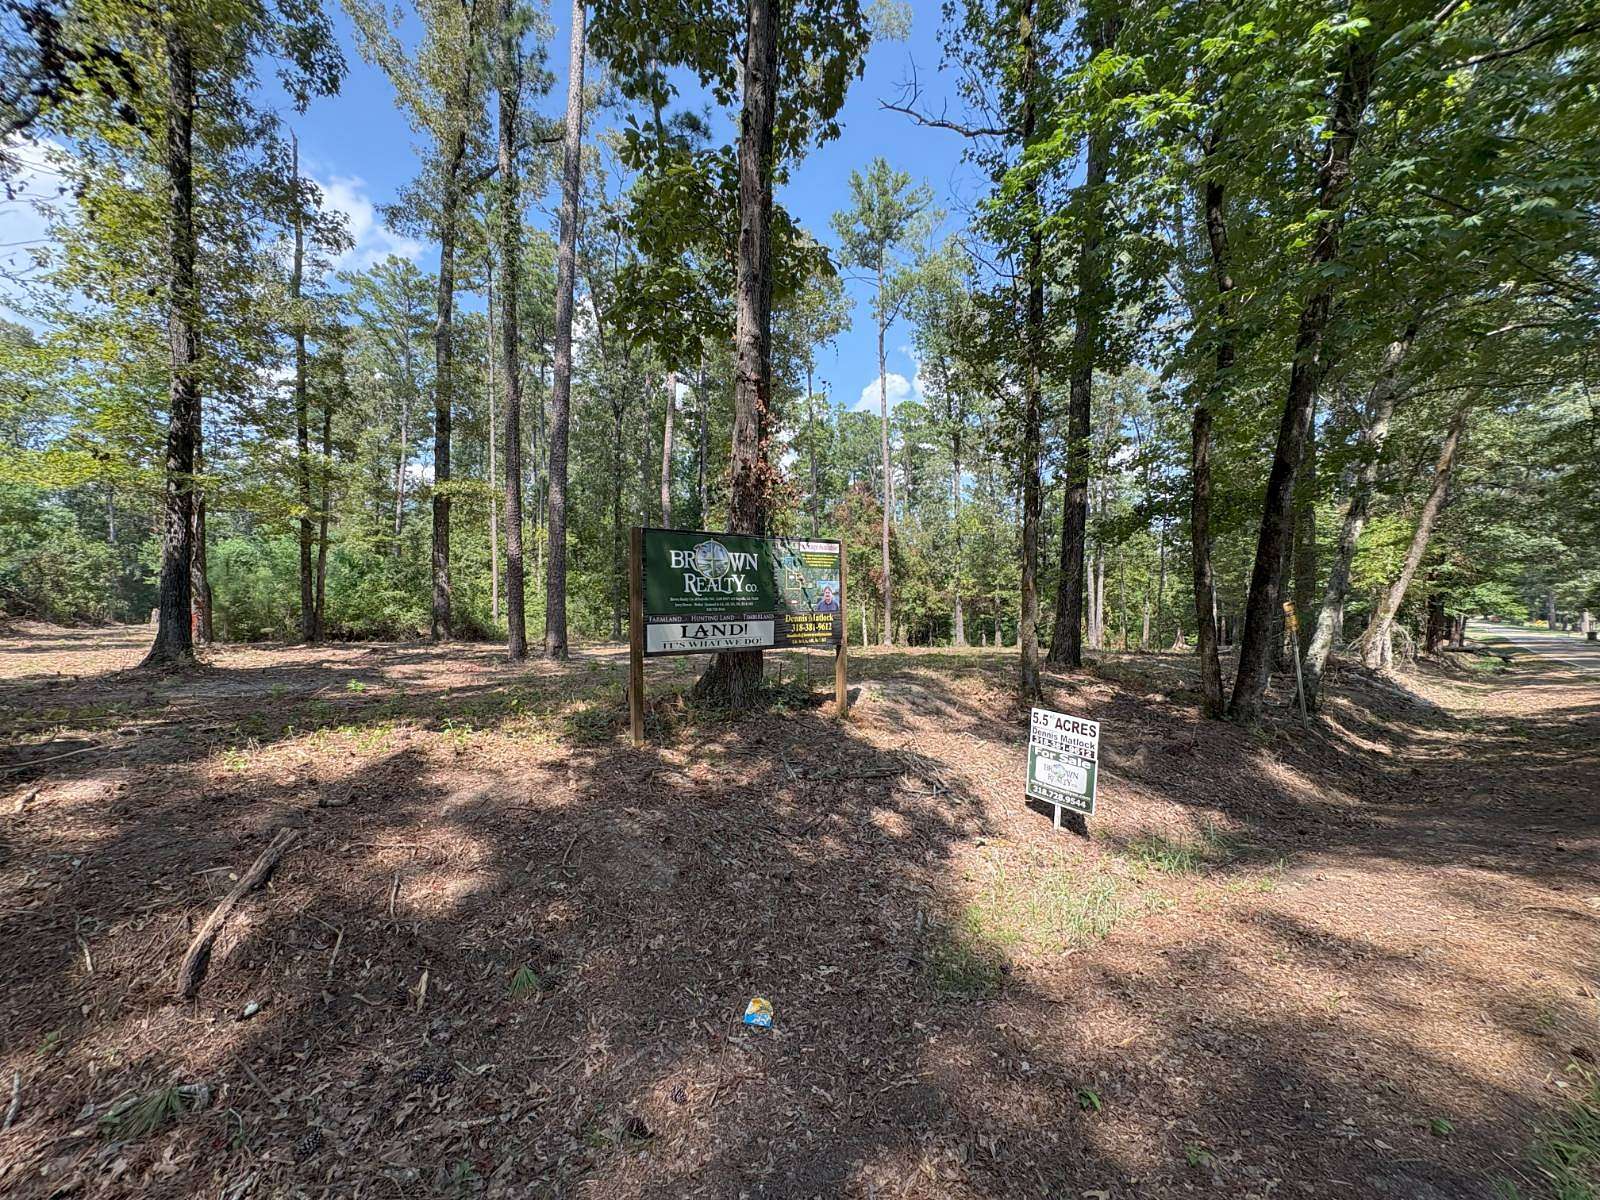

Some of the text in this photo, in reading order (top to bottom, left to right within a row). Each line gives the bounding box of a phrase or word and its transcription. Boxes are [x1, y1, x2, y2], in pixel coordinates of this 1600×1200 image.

[683, 573, 745, 596] REALTY
[649, 615, 682, 623] FARMLAND
[691, 614, 720, 622] HUNTING
[785, 613, 807, 622] Dennis
[680, 623, 748, 639] LAND!
[791, 622, 833, 632] 318-381-9612
[688, 640, 720, 648] WHAT
[1055, 717, 1097, 738] ACRES
[1032, 726, 1095, 750] Dennis Matlock
[1034, 746, 1091, 770] For Sale
[1032, 785, 1087, 809] 318.728.9544
